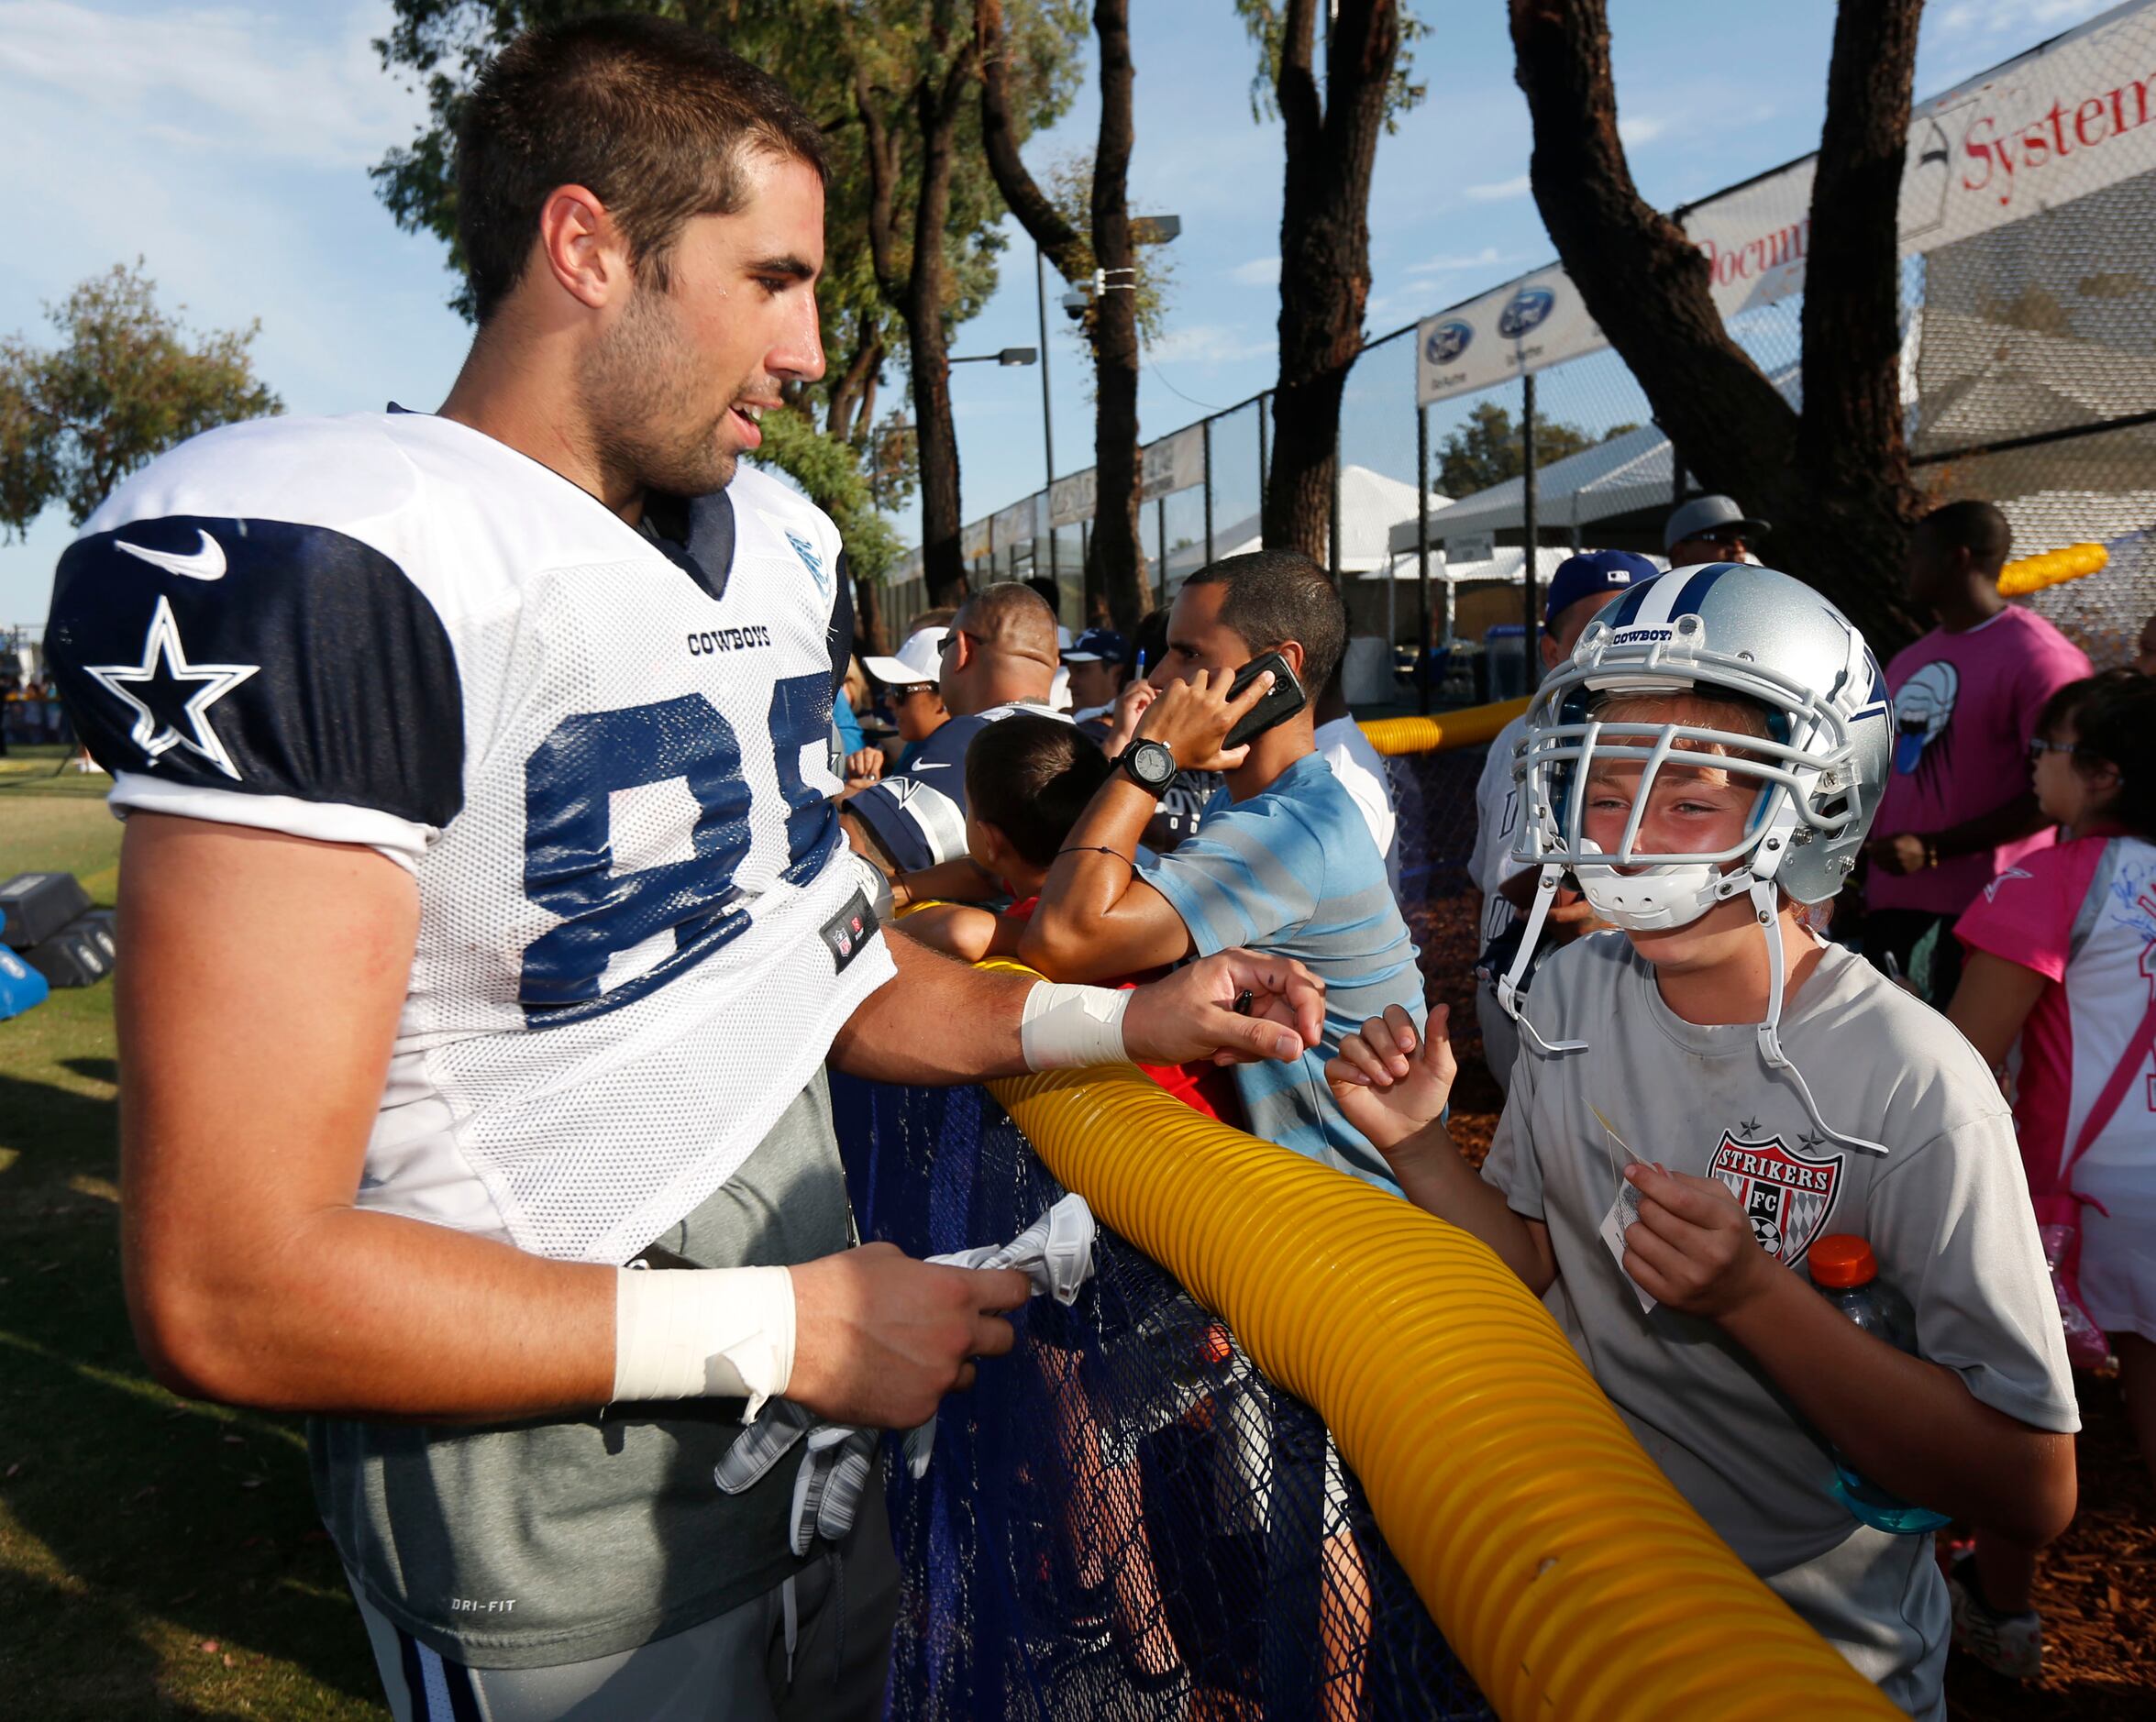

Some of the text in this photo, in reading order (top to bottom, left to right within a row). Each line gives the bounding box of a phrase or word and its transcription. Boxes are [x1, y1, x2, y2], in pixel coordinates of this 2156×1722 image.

[687, 625, 770, 656] COWBOYS
[1717, 1148, 1829, 1192] STRIKERS
[1751, 1190, 1777, 1212] FC
[451, 1598, 516, 1612] DRI-FIT
